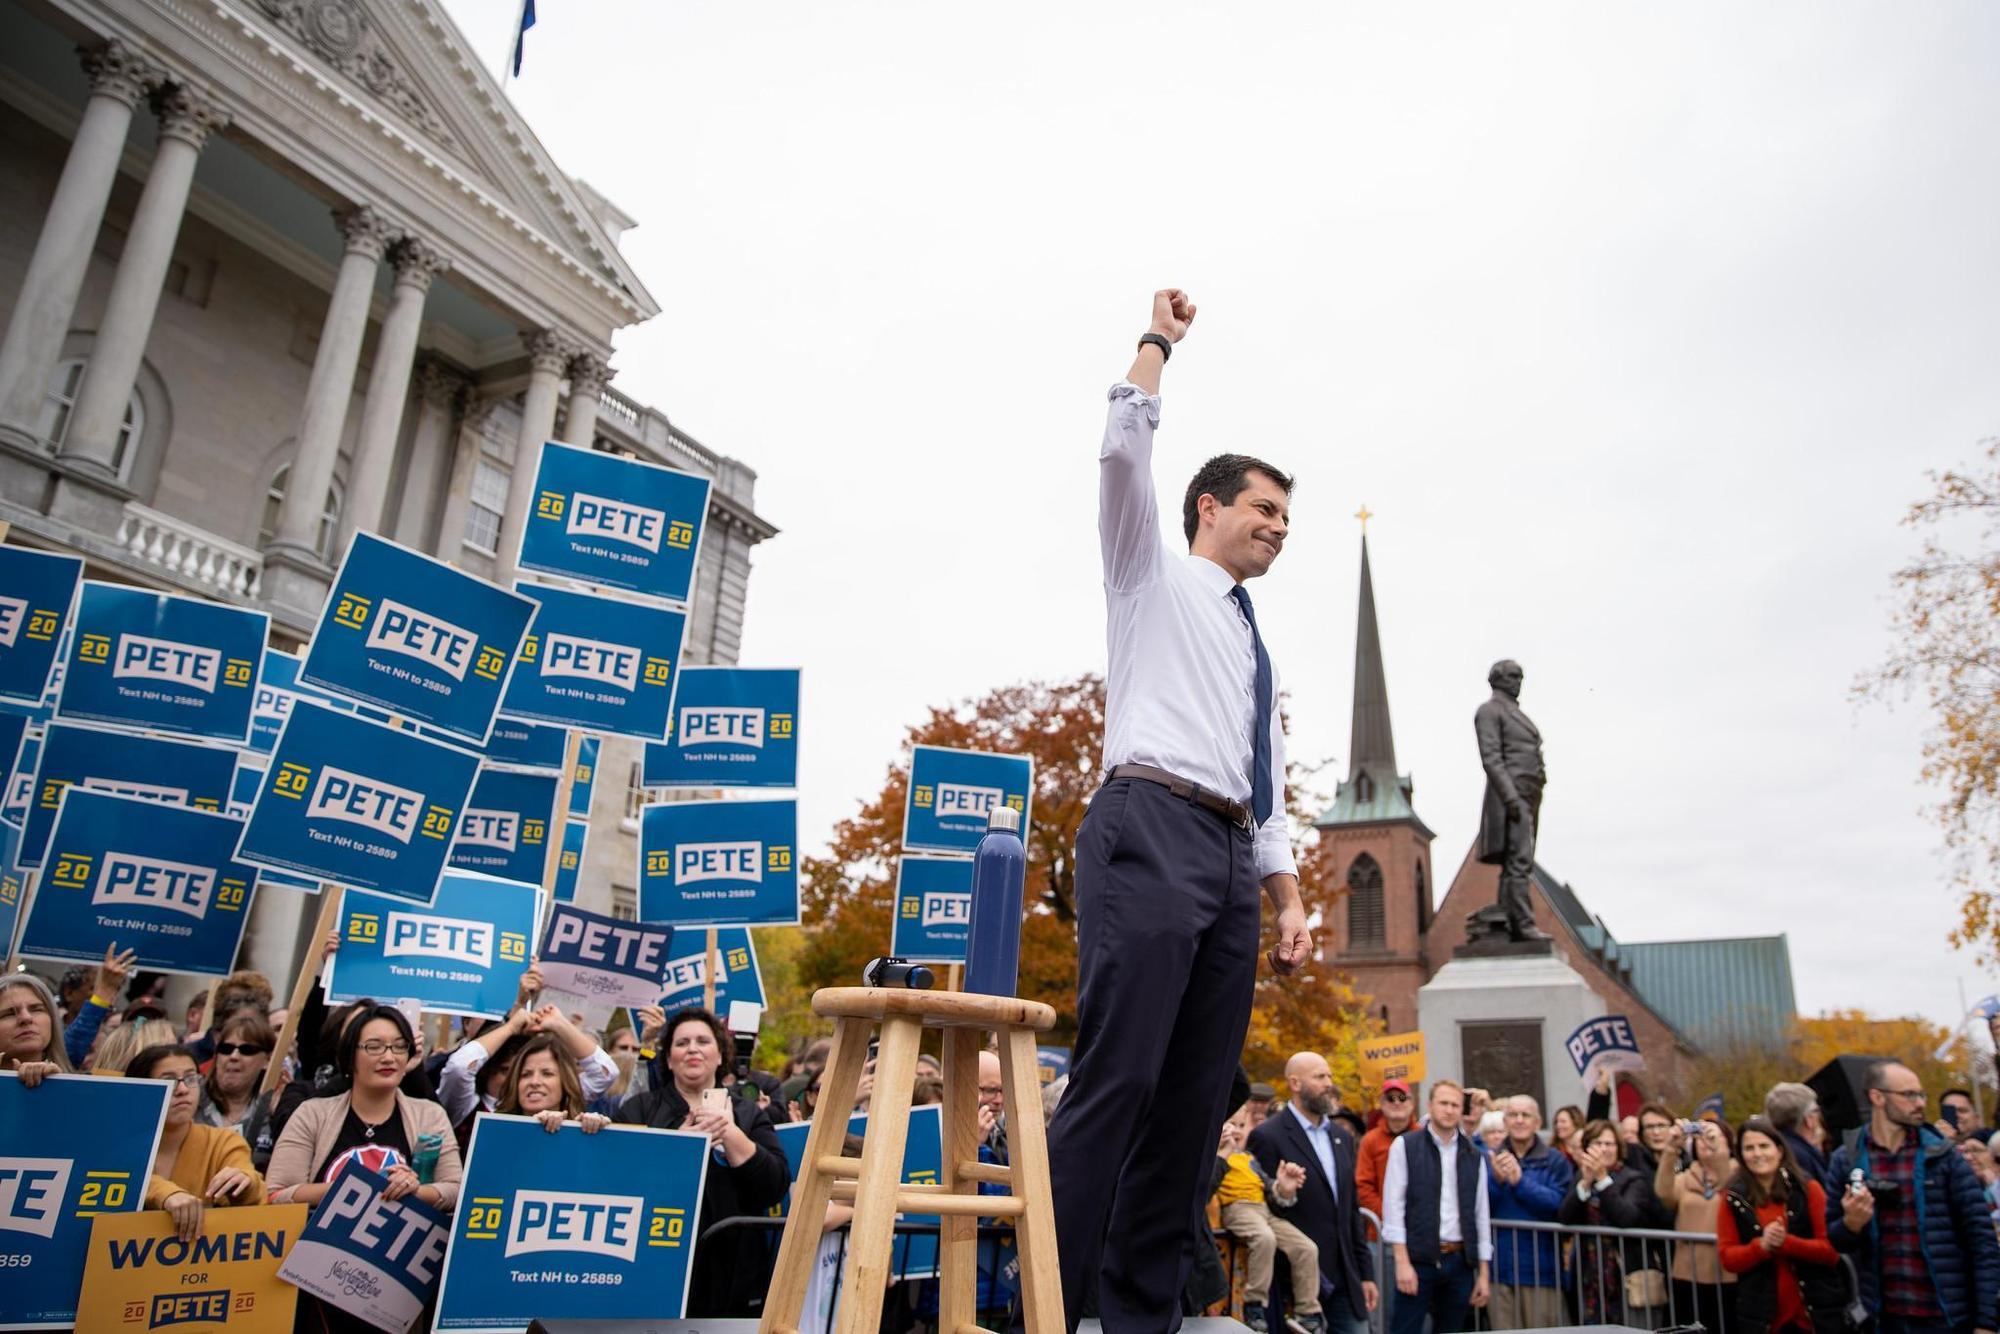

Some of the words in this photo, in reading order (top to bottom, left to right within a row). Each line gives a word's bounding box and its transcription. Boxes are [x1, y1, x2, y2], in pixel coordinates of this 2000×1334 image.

[538, 498, 564, 515] 20
[575, 501, 658, 542] PETE
[668, 526, 692, 544] 20
[570, 542, 592, 554] Text
[592, 546, 608, 558] NH
[610, 550, 619, 560] to
[620, 554, 650, 567] 25859
[28, 616, 57, 634] 20
[336, 600, 368, 623] 20
[378, 609, 470, 668] PETE
[477, 654, 504, 674] 20
[80, 640, 110, 658] 20
[123, 642, 214, 682] PETE
[224, 664, 250, 681] 20
[550, 641, 634, 680] PETE
[644, 662, 668, 680] 20
[368, 658, 391, 676] Text
[392, 667, 410, 682] NH
[411, 675, 422, 686] to
[422, 678, 452, 696] 25859
[118, 686, 140, 698] Text
[142, 690, 160, 700] NH
[162, 694, 172, 702] to
[256, 690, 290, 714] PE
[545, 684, 566, 697] Text
[567, 688, 583, 700] NH
[584, 691, 594, 702] to
[596, 693, 626, 706] 25859
[686, 714, 758, 738] PETE
[770, 720, 792, 732] 20
[718, 754, 728, 762] to
[276, 770, 308, 793] 20
[318, 776, 416, 830] PETE
[424, 814, 450, 834] 20
[942, 790, 997, 812] PETE
[460, 815, 512, 842] ETE
[523, 825, 544, 838] 20
[308, 829, 332, 844] Text
[334, 836, 352, 848] NH
[354, 841, 364, 852] to
[366, 843, 398, 860] 25859
[647, 856, 669, 870] 20
[682, 848, 755, 876] PETE
[768, 850, 790, 866] 20
[54, 862, 90, 881] 20
[104, 861, 208, 906] PETE
[217, 886, 244, 904] 20
[681, 891, 700, 900] Text
[702, 890, 716, 899] NH
[716, 890, 727, 898] to
[928, 899, 970, 919] PET
[96, 916, 124, 928] Text
[126, 920, 146, 931] NH
[147, 922, 158, 932] to
[160, 924, 192, 936] 25859
[349, 922, 378, 937] 20
[392, 919, 486, 957] PETE
[500, 938, 524, 956] 20
[548, 913, 668, 973] PETE
[390, 965, 413, 976] Text
[416, 968, 434, 978] NH
[436, 970, 448, 980] to
[449, 971, 482, 984] 25859
[660, 959, 719, 992] PET
[1568, 1020, 1633, 1069] PETE
[78, 1183, 126, 1207] 20
[316, 1174, 450, 1286] PETE
[468, 1208, 502, 1230] 20
[516, 1201, 633, 1246] PETE
[649, 1218, 684, 1238] 20
[0, 1254, 32, 1268] 859
[108, 1230, 286, 1270] WOMEN
[181, 1272, 208, 1284] FOR
[510, 1270, 538, 1282] Text
[540, 1272, 562, 1283] NH
[564, 1272, 578, 1284] to
[580, 1272, 622, 1285] 25859
[124, 1306, 144, 1318] 20
[155, 1294, 226, 1322] PETE
[235, 1297, 255, 1308] 20
